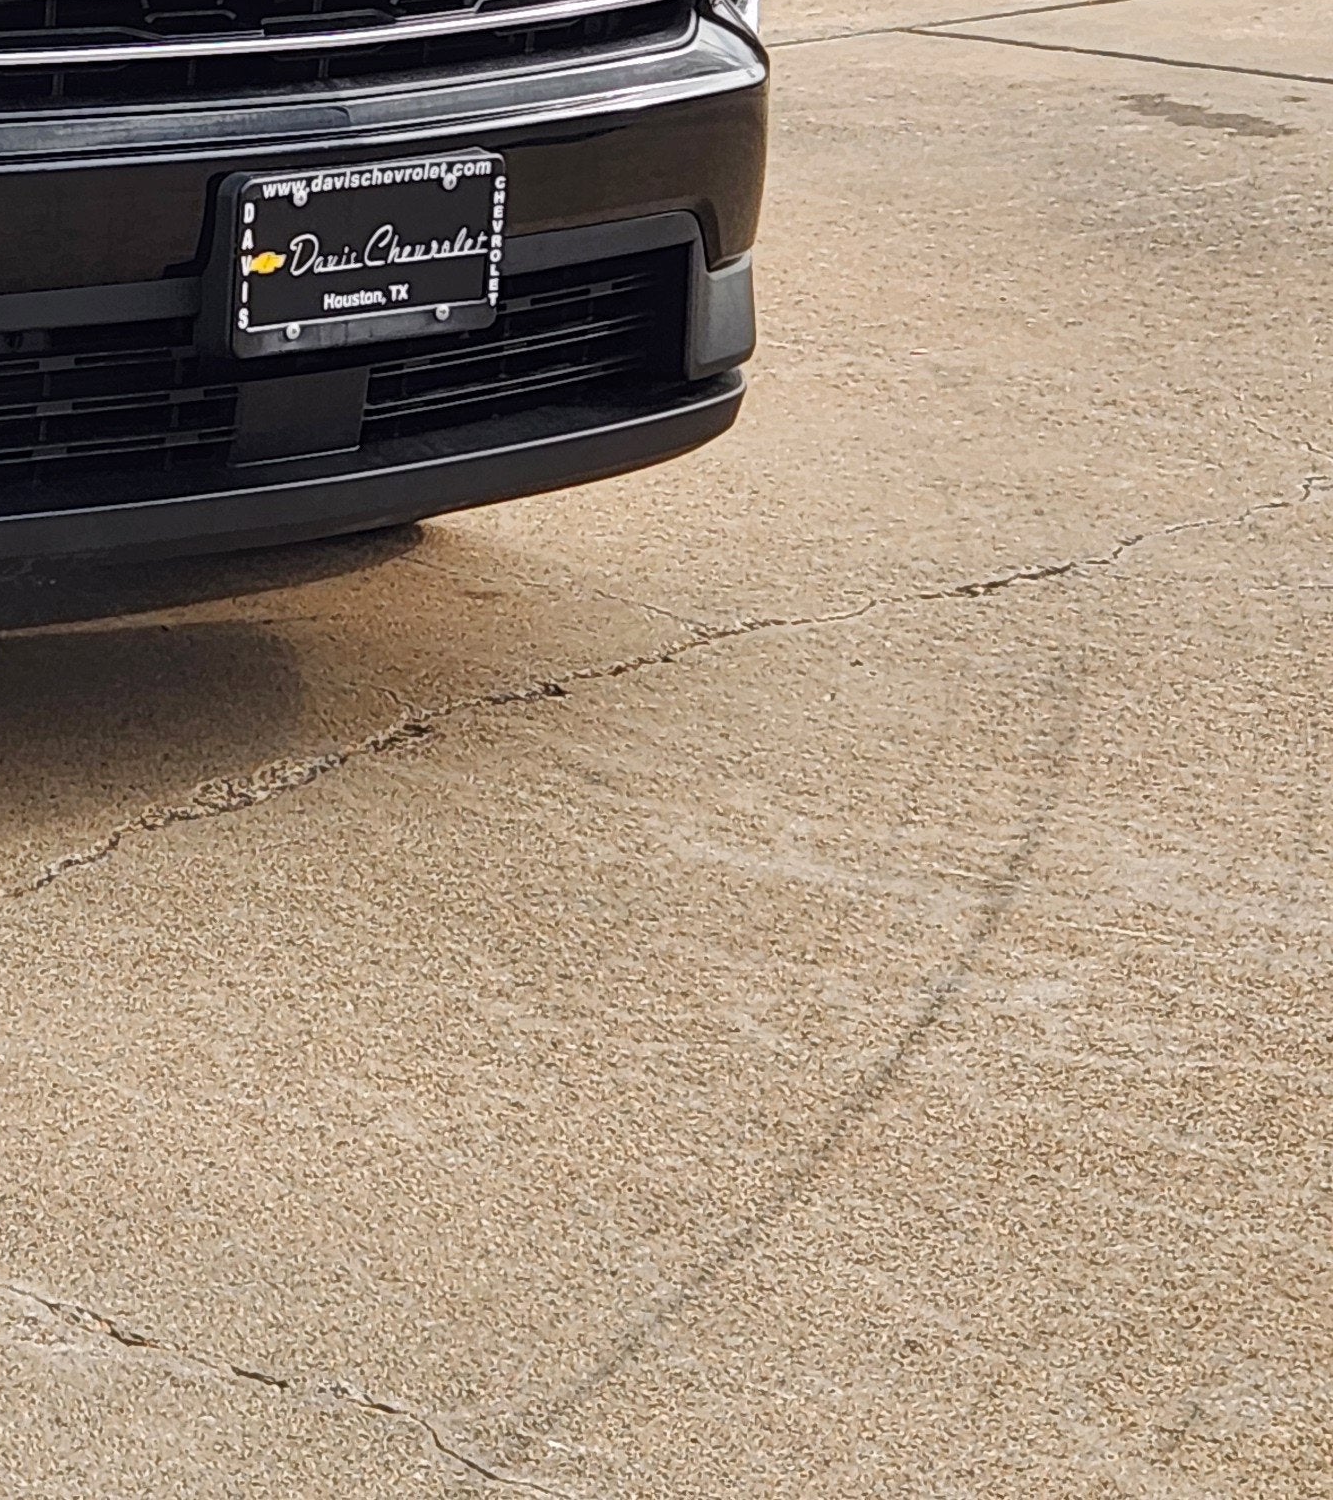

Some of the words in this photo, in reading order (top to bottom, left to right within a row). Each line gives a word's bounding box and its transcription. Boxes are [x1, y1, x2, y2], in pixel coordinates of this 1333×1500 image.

[262, 160, 492, 200] www.davischevrolet.com
[238, 202, 255, 330] DAVIS
[289, 233, 364, 277] Davis
[364, 224, 488, 267] Chevrolet
[488, 175, 507, 307] CHEVROLET
[323, 289, 387, 311] Houston,
[388, 283, 410, 301] TX
